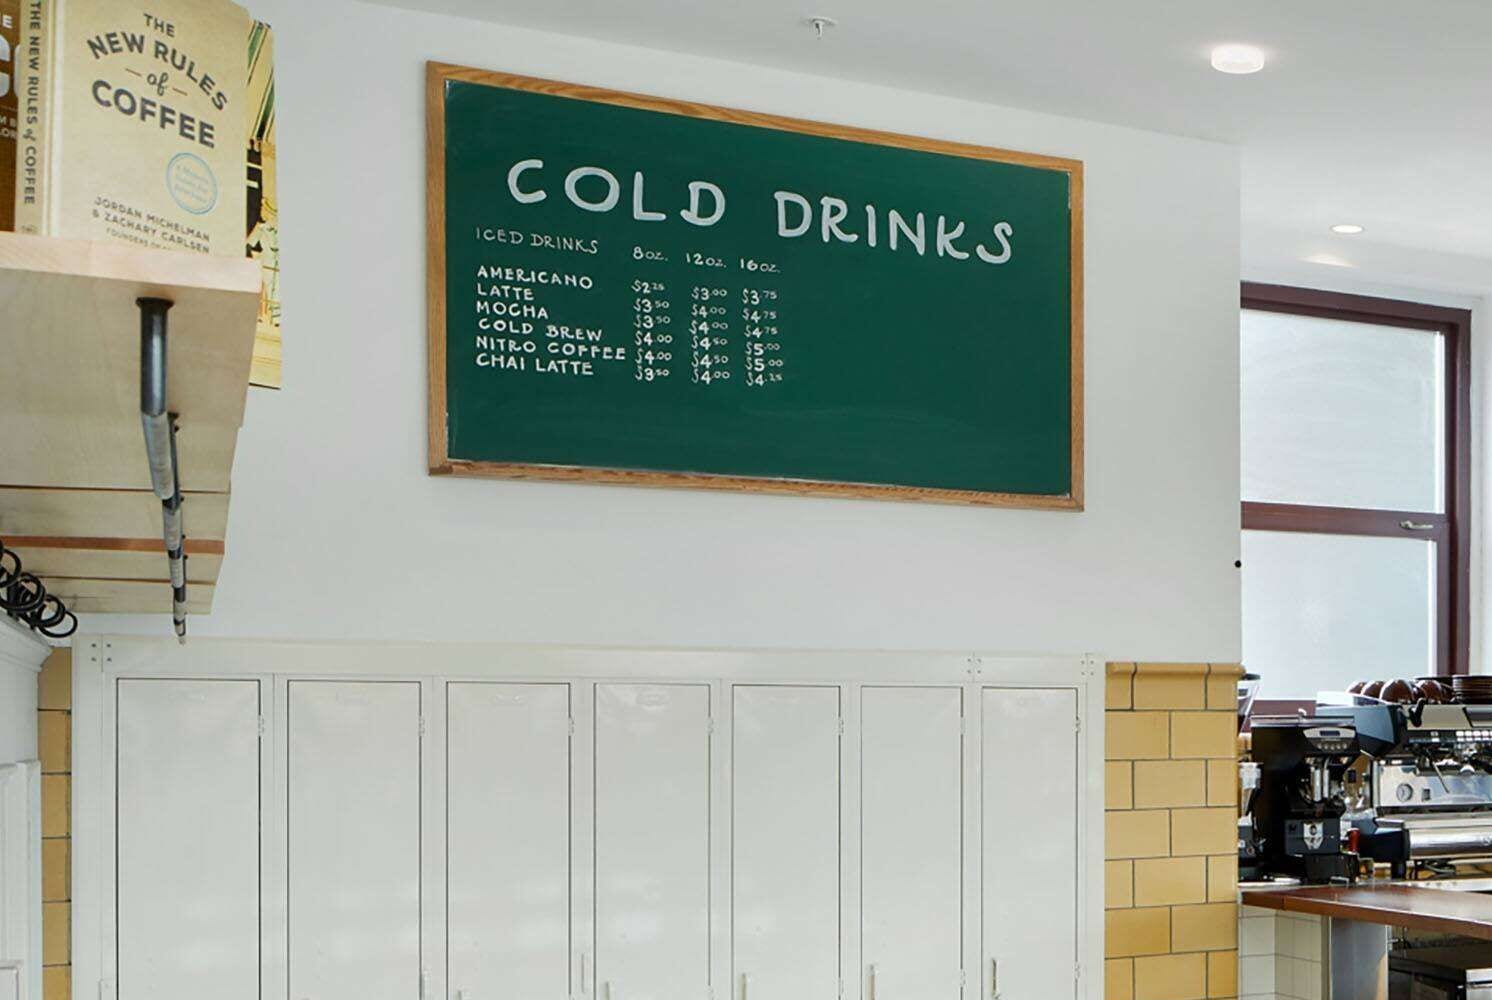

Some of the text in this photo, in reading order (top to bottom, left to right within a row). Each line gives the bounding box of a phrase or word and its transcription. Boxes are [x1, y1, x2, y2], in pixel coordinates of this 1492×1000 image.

[143, 12, 175, 38] THE
[86, 31, 228, 111] NEW RULES
[146, 72, 169, 96] of
[22, 1, 41, 205] THE NEW RULES of COFFEE
[91, 79, 215, 149] COFFEE
[94, 196, 210, 242] JORDAN MICHELMAN
[506, 158, 1015, 265] COLD DRINKS
[104, 212, 156, 235] ZACHARY
[161, 232, 210, 253] CARLSEN
[476, 227, 524, 245] ICED
[530, 233, 599, 254] DRINKS
[477, 265, 593, 290] AMERICANO
[477, 283, 534, 301] LATTE
[476, 301, 549, 320] MOCHA
[478, 318, 534, 335] COLD
[545, 324, 602, 342] BREW
[476, 335, 537, 353] NITRO
[547, 342, 626, 360] COFFEE
[476, 353, 525, 371] CHAI
[535, 358, 594, 376] LATTE
